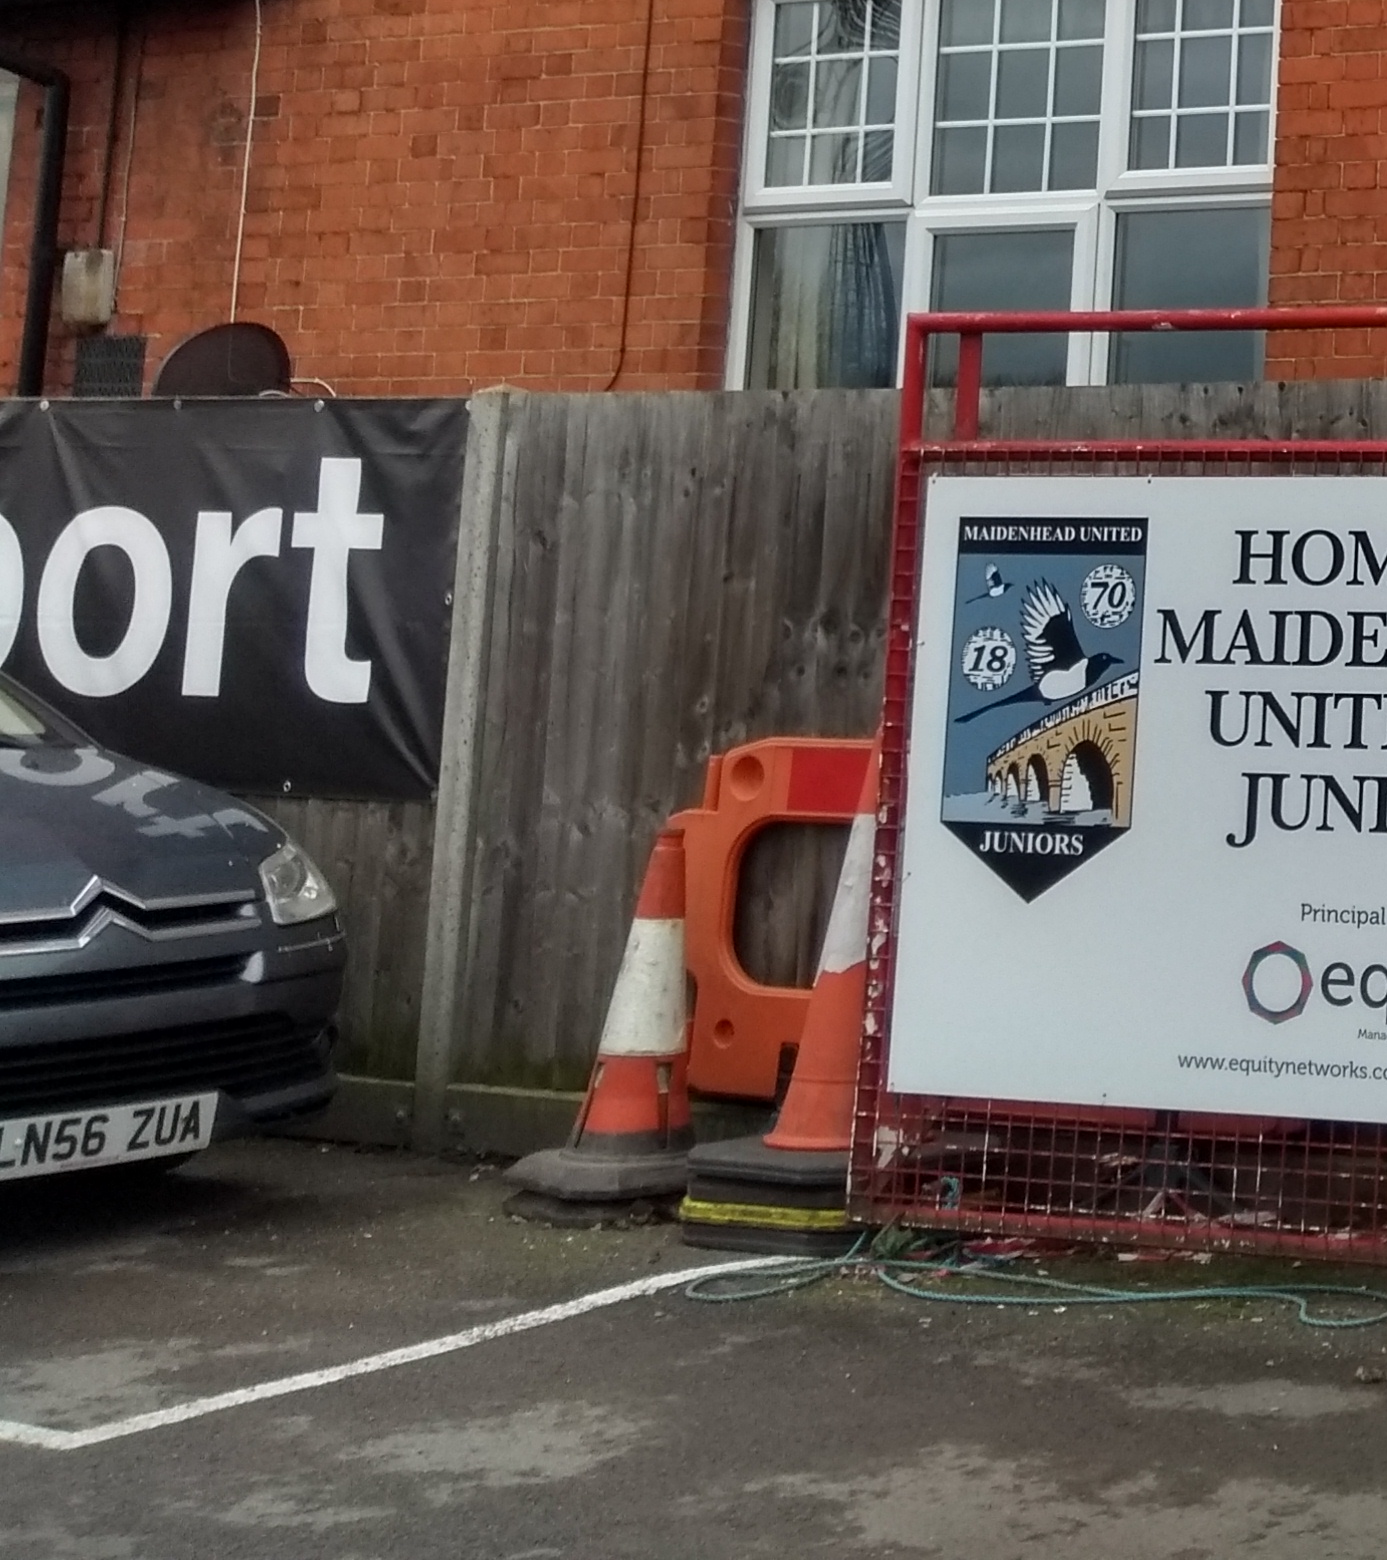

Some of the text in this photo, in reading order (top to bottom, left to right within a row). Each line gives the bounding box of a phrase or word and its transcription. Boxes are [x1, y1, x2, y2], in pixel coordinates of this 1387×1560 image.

[964, 526, 1142, 542] MAIDENHEAD UNITED
[0, 457, 384, 703] ort
[1090, 581, 1126, 610] 70
[968, 645, 1008, 672] 18
[979, 830, 1083, 855] JUNIORS
[1300, 903, 1386, 929] Principal
[127, 1100, 200, 1152] ZUA
